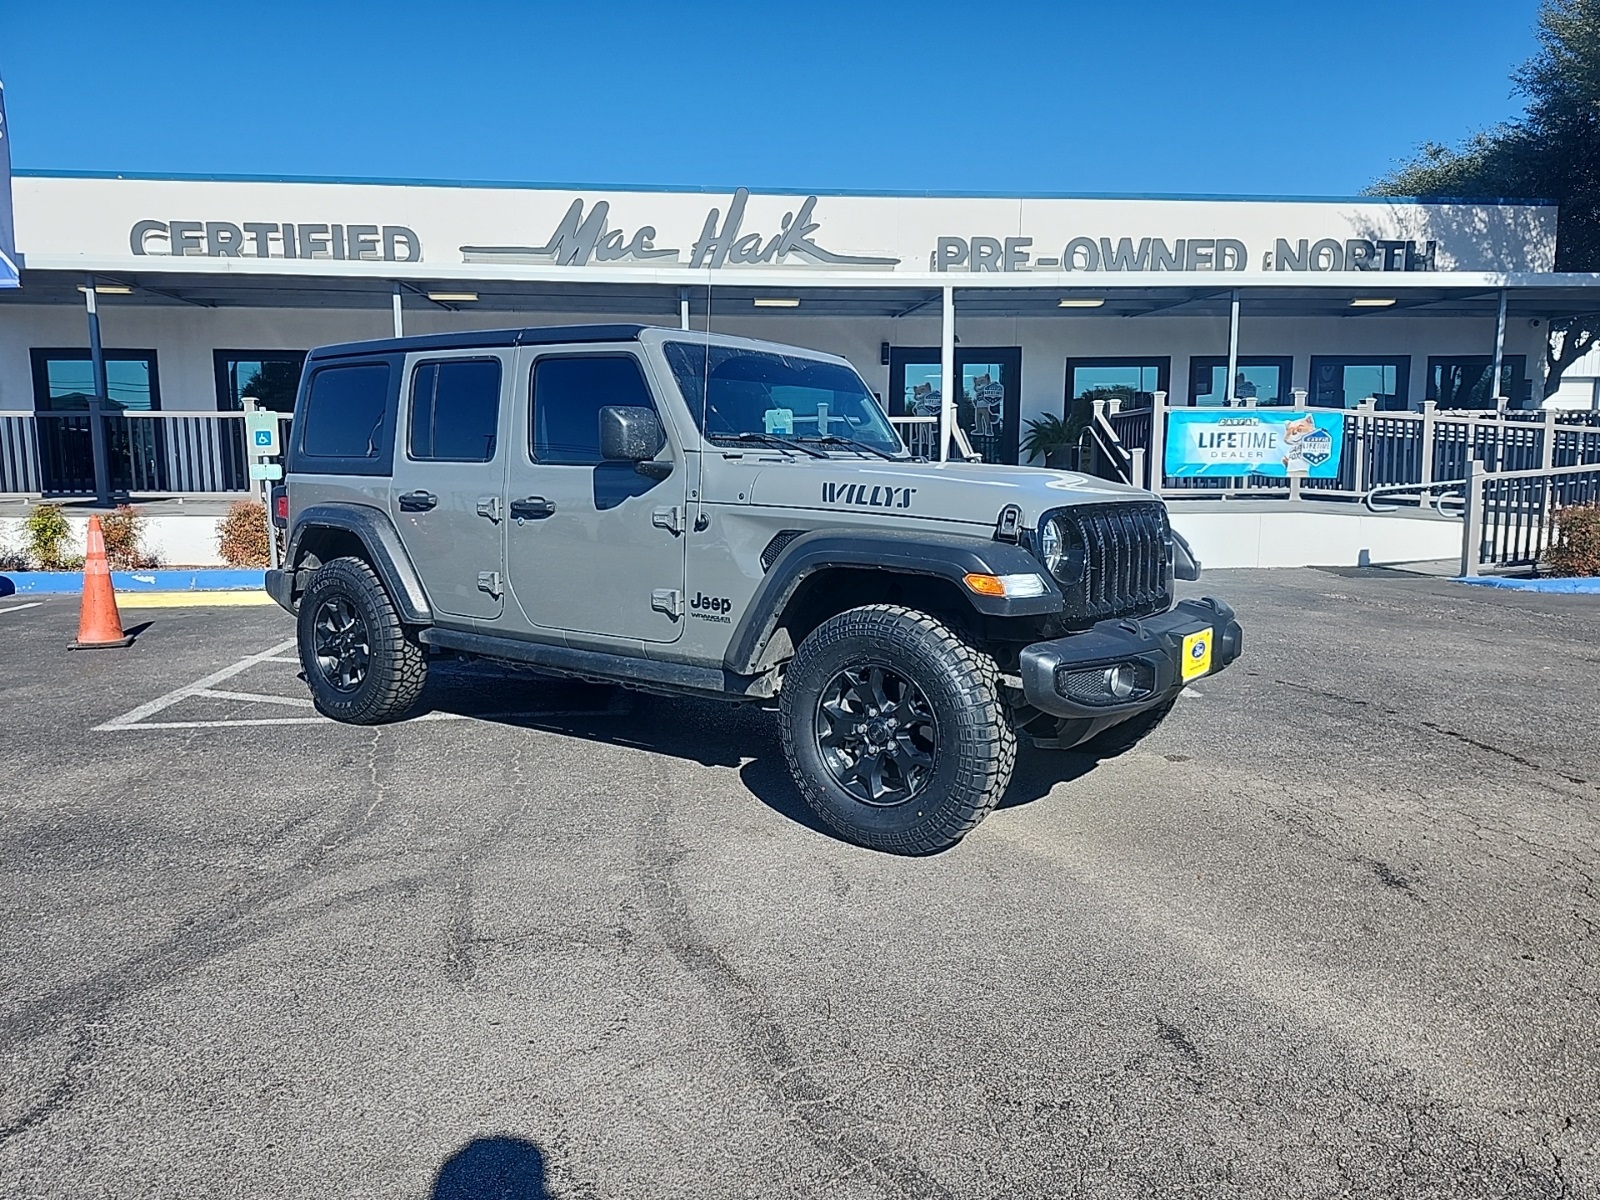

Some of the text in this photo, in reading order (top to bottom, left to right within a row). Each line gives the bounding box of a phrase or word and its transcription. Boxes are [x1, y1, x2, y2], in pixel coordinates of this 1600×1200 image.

[129, 219, 421, 262] CERTIFIED
[545, 187, 838, 268] Mac Haik
[935, 236, 1436, 272] PRE-OWNED NORTH
[1198, 432, 1278, 449] LIFETIME
[821, 482, 917, 509] WILLYS
[690, 591, 732, 615] Jeep
